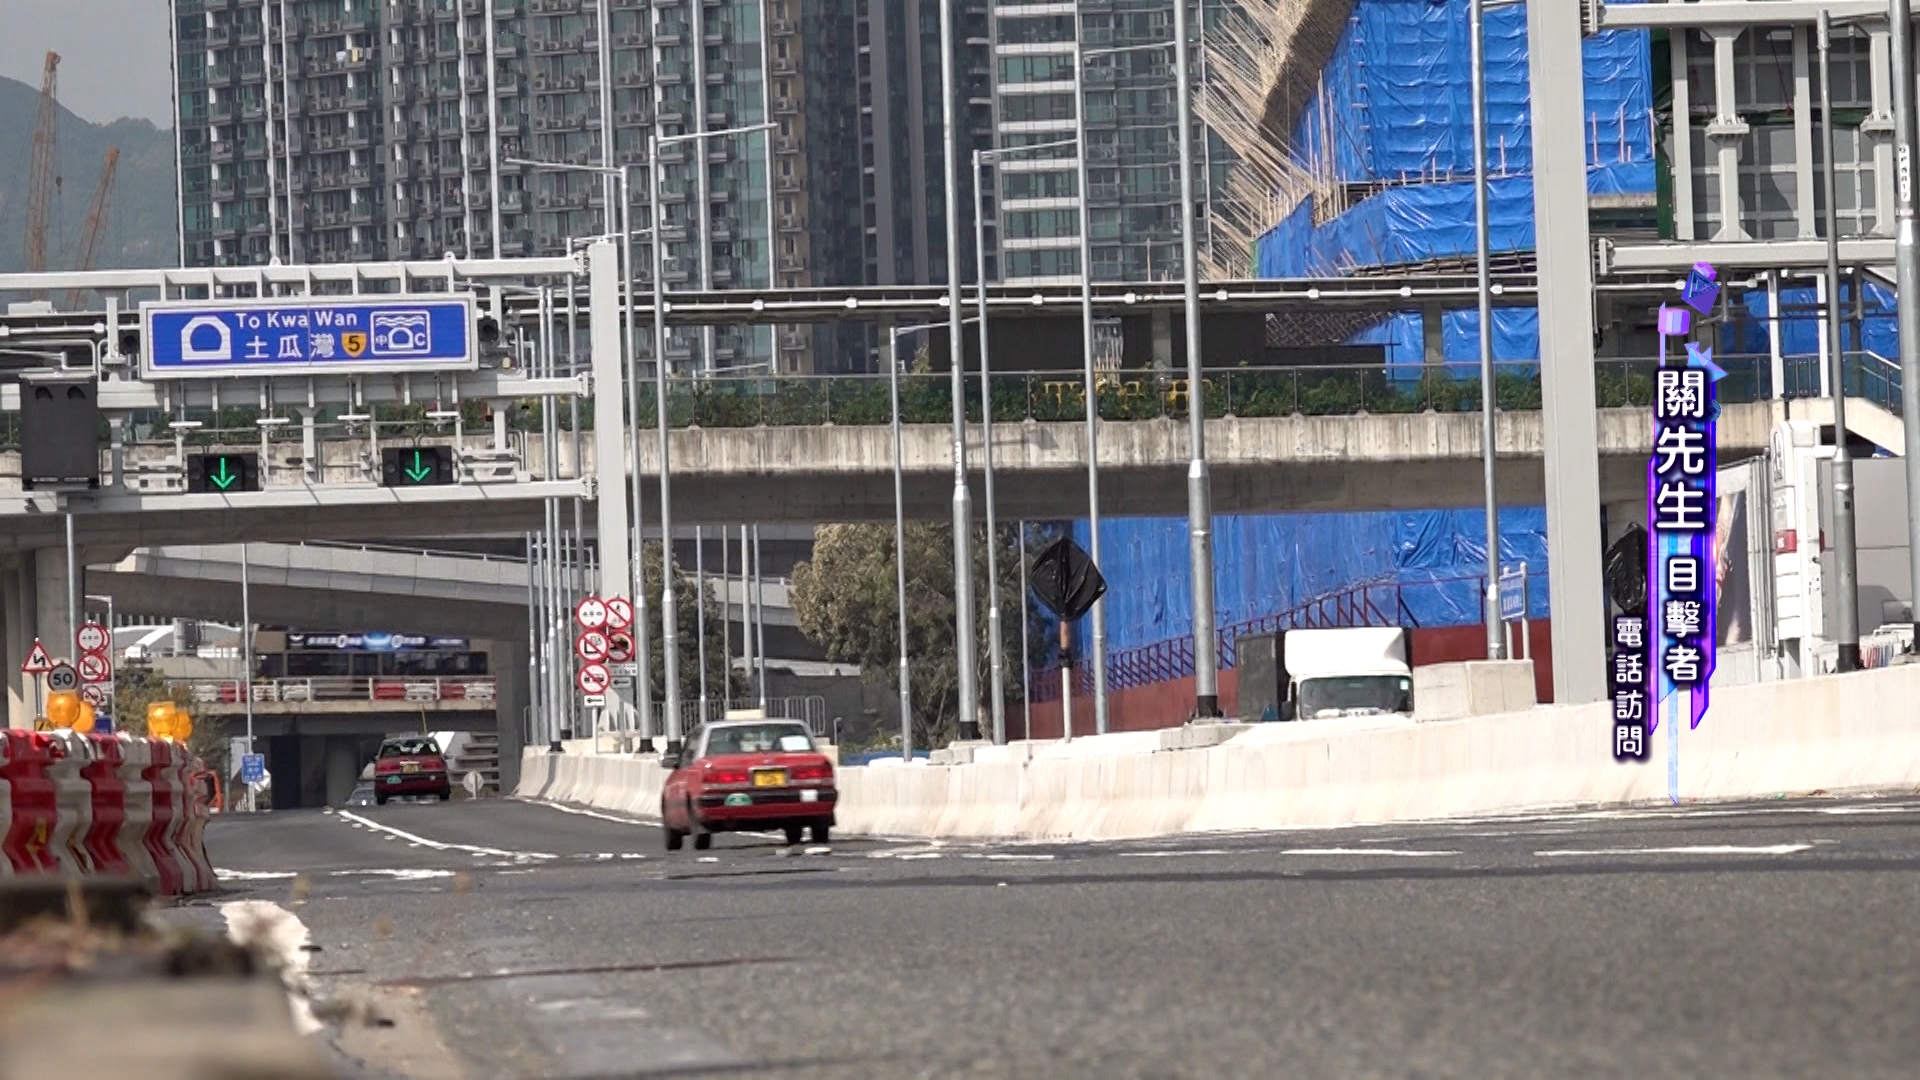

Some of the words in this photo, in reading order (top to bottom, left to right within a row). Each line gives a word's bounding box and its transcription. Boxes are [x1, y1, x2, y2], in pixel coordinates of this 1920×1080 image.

[235, 312, 260, 328] To
[267, 311, 308, 327] Kwa
[315, 310, 357, 326] Wan
[348, 335, 360, 351] 5
[415, 332, 426, 346] C
[54, 673, 73, 686] 50
